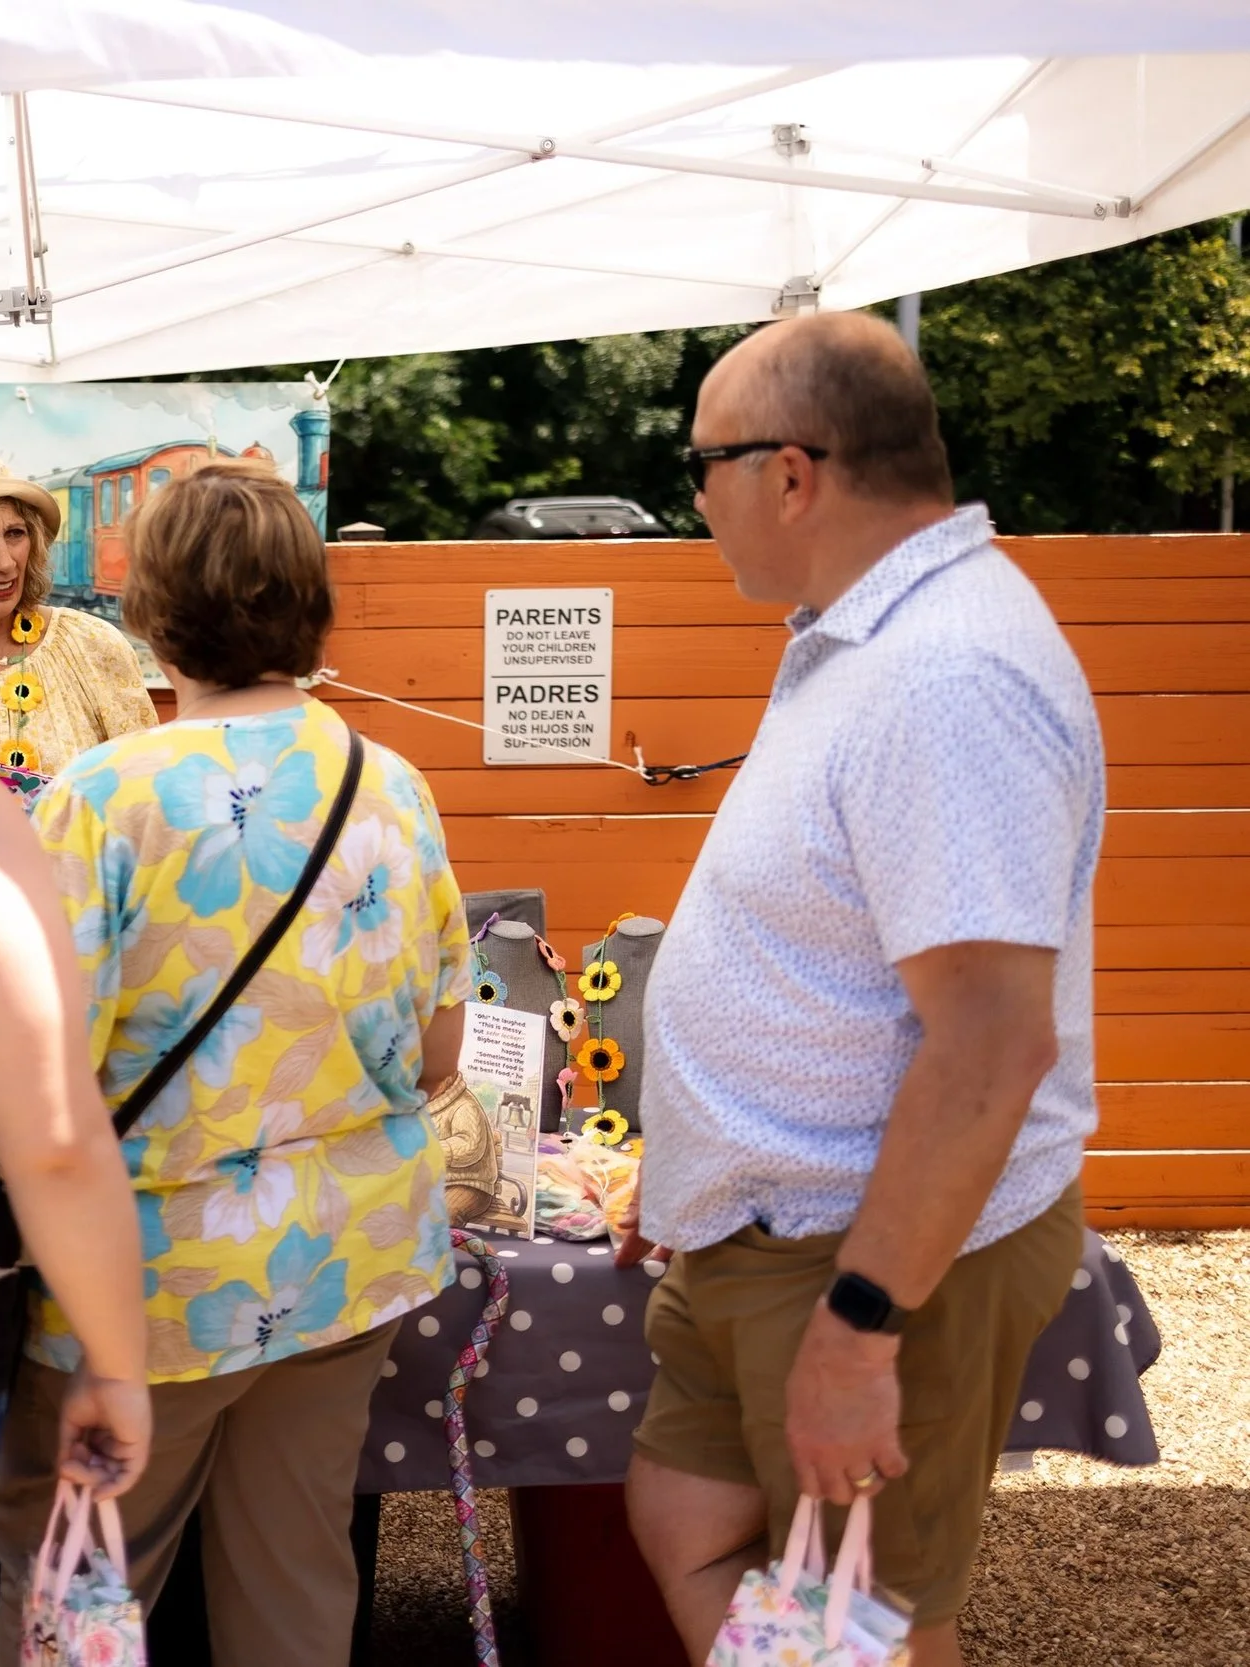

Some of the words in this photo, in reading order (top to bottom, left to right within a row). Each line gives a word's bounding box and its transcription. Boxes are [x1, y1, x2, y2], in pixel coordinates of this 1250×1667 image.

[496, 608, 601, 626] PARENTS
[506, 631, 524, 641] DO
[527, 631, 551, 640] NOT
[554, 631, 590, 640] LEAVE
[502, 644, 535, 653] YOUR
[538, 643, 596, 652] CHILDREN
[504, 655, 593, 665] UNSUPERVISED
[496, 685, 599, 704] PADRES
[508, 711, 527, 720] NO
[531, 710, 574, 720] DEJEN
[576, 710, 586, 719] A
[501, 724, 527, 734] SUS
[531, 724, 569, 734] HIJOS
[573, 723, 594, 733] SIN
[502, 1041, 526, 1050] nodded
[473, 1058, 501, 1067] messiest
[502, 1063, 517, 1071] food
